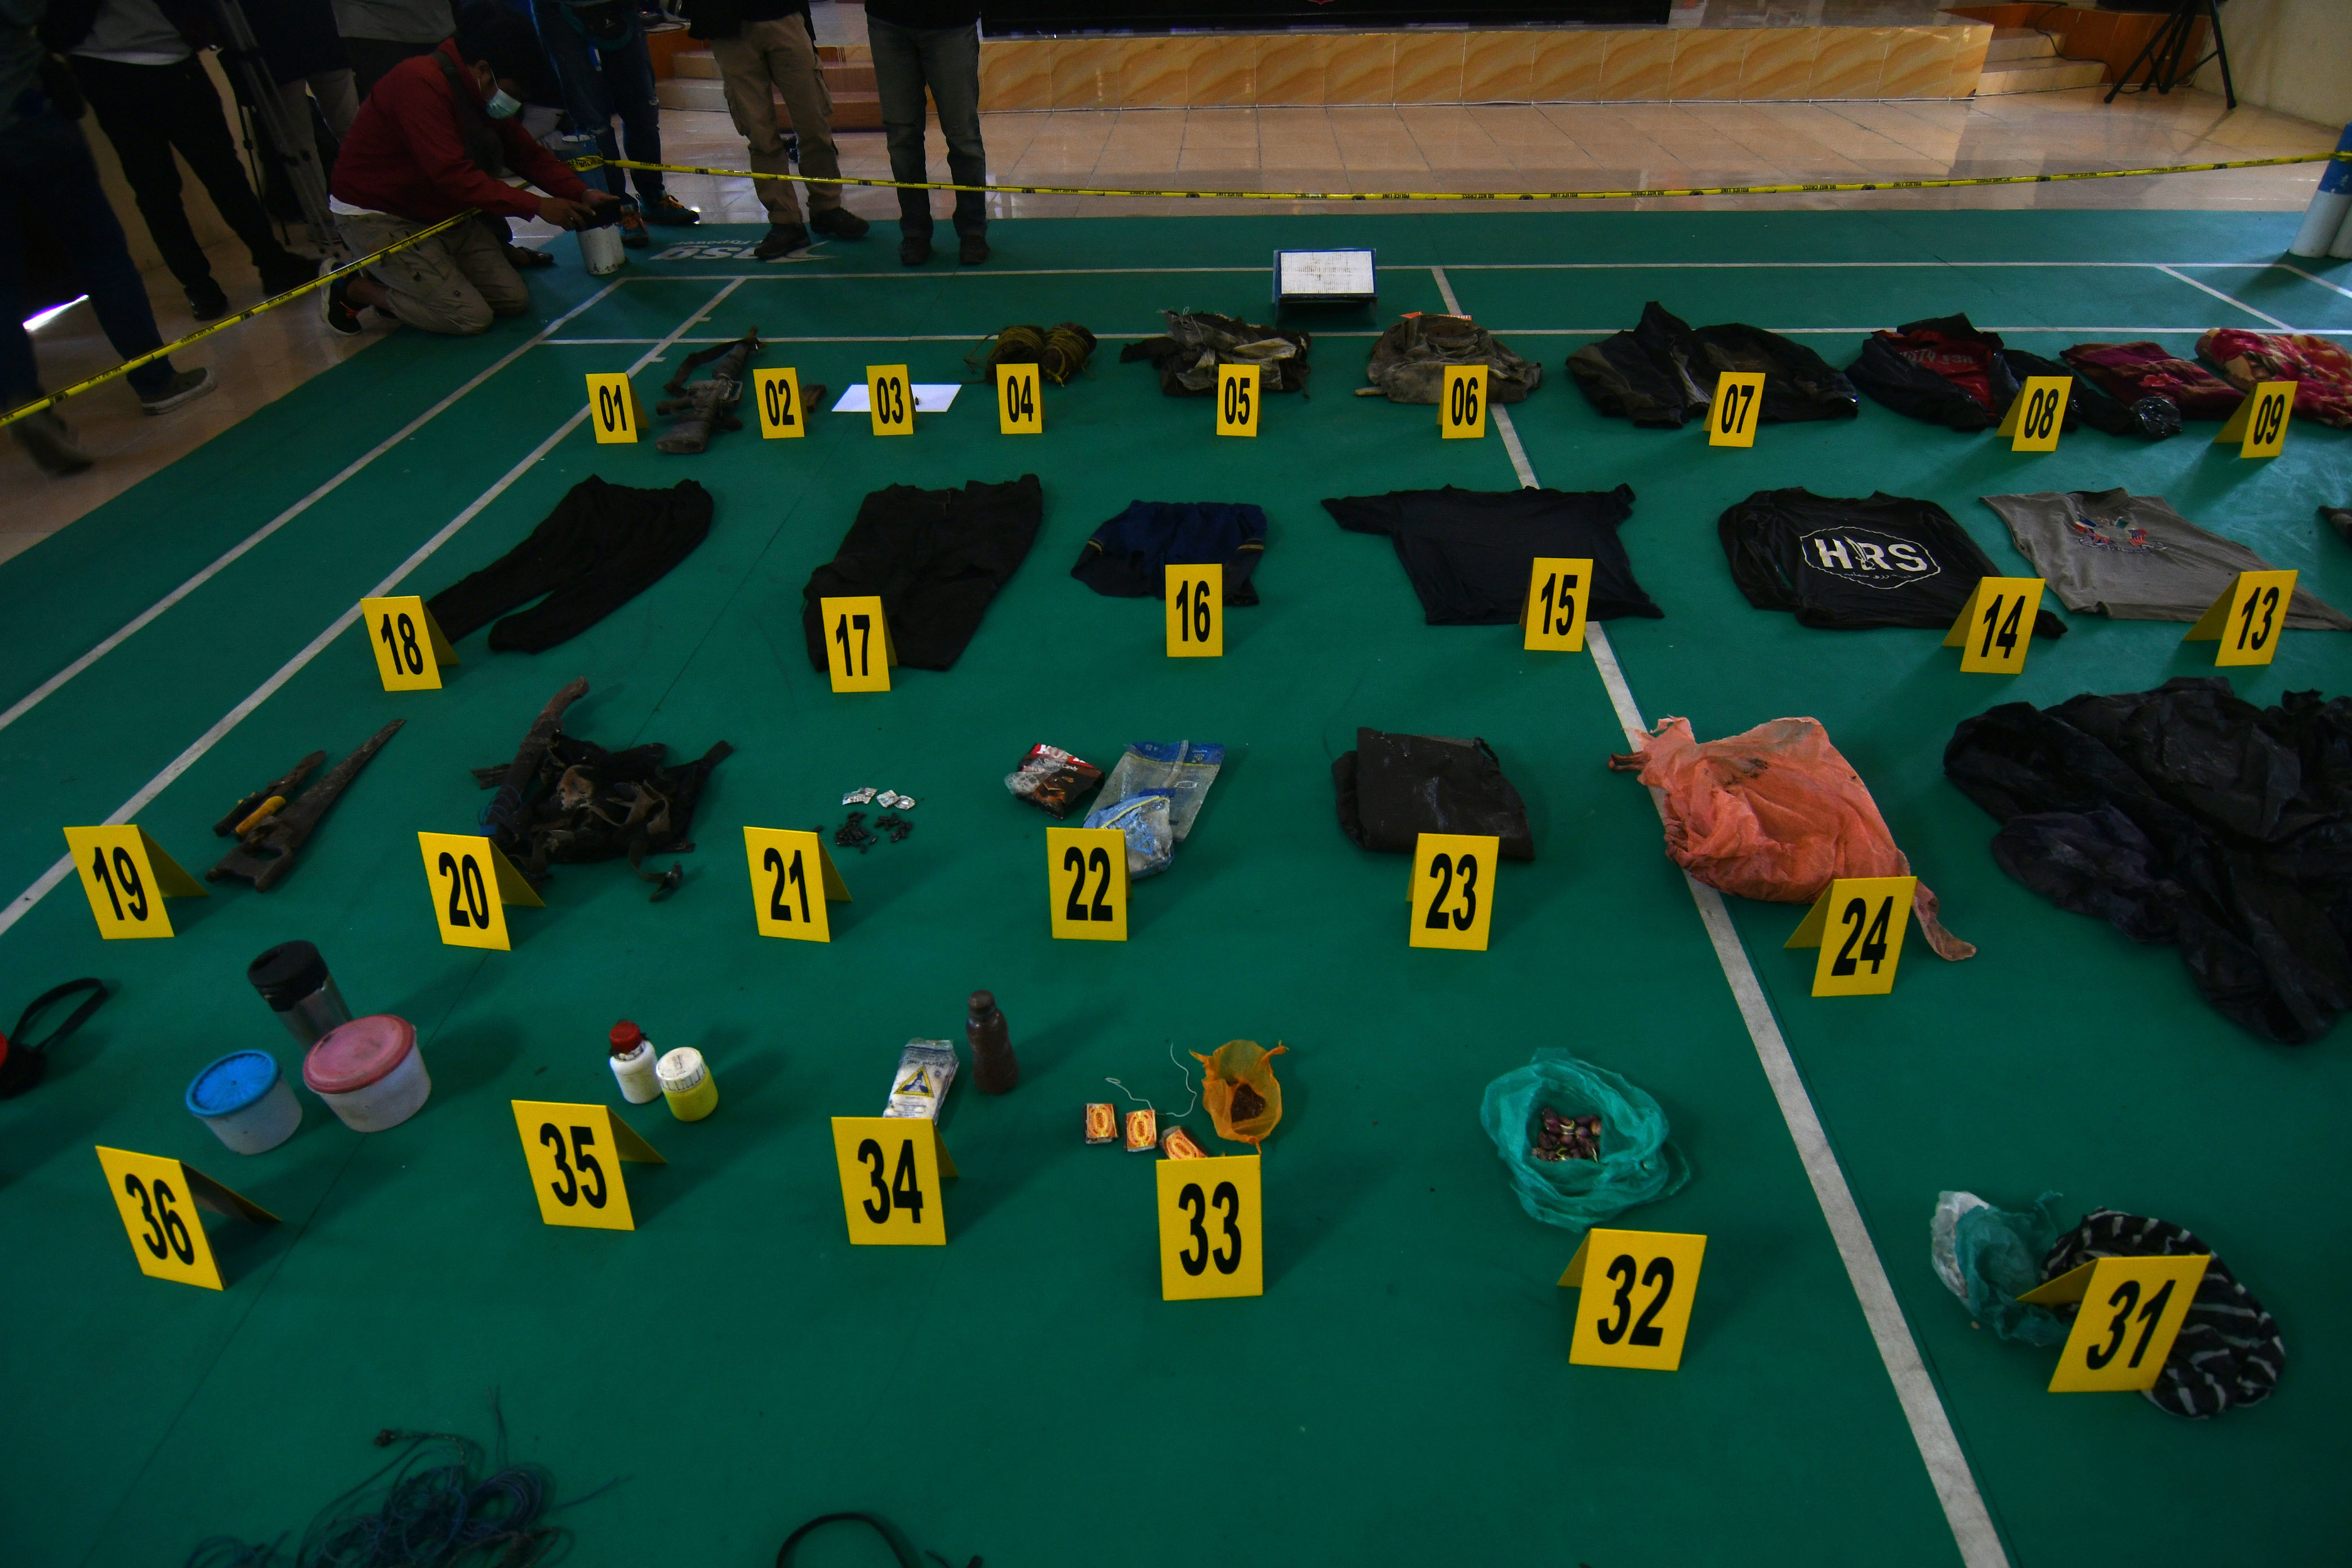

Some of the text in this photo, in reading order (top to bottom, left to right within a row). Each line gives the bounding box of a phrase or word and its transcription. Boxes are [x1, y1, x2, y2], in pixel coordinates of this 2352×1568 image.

[599, 385, 627, 432] 01
[765, 379, 795, 426] 02
[876, 377, 904, 424] 03
[1007, 375, 1034, 423] 04
[1224, 376, 1250, 425] 05
[1451, 377, 1478, 426] 06
[1721, 384, 1755, 434] 07
[2024, 388, 2059, 439] 08
[2253, 394, 2285, 446] 09
[1814, 537, 1928, 572] HRS
[1176, 580, 1210, 643] 16
[1540, 573, 1578, 636] 15
[1980, 594, 2026, 659] 14
[2237, 586, 2279, 651] 13
[380, 613, 424, 675] 18
[836, 614, 870, 676] 17
[92, 847, 148, 921] 19
[439, 852, 489, 930] 20
[764, 848, 810, 923] 21
[1063, 847, 1113, 922] 22
[1425, 853, 1478, 931] 23
[1830, 896, 1894, 977] 24
[540, 1122, 607, 1209] 35
[857, 1138, 924, 1224] 34
[124, 1174, 194, 1266] 36
[1178, 1181, 1242, 1276] 33
[1597, 1254, 1674, 1347] 32
[2086, 1279, 2176, 1370] 31
